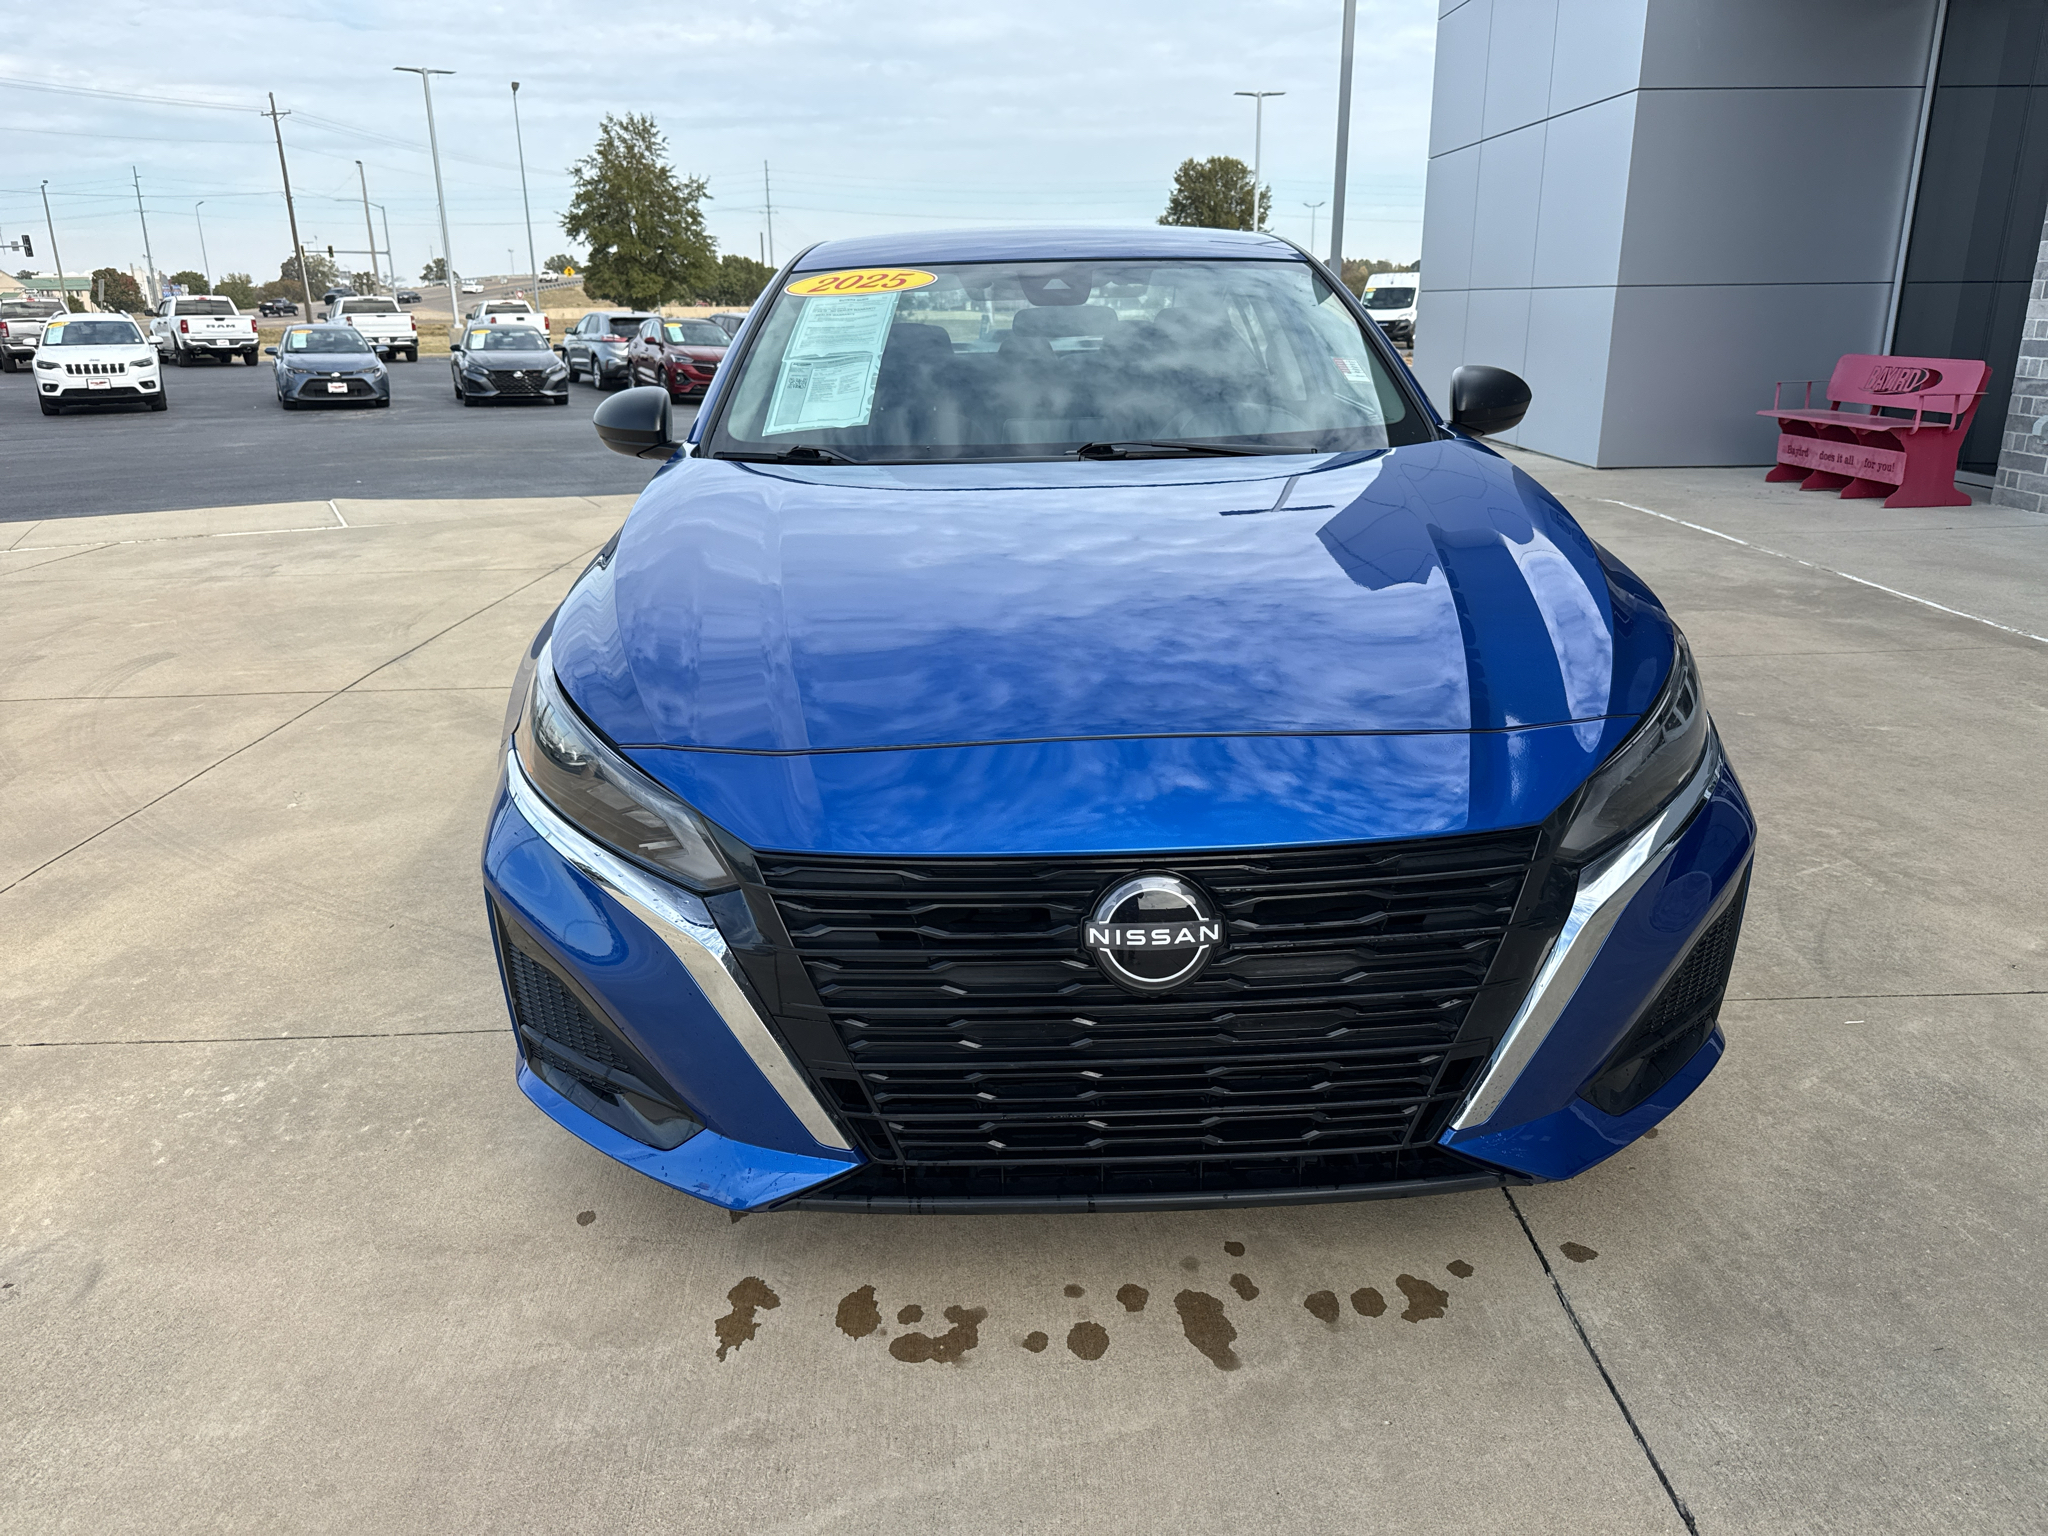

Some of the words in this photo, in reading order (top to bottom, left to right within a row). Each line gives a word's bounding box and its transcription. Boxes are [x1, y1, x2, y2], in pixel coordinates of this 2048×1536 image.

[807, 273, 915, 293] 2025
[1864, 365, 1922, 392] BAYIRD
[1787, 444, 1809, 458] Bayird
[1819, 450, 1835, 462] does
[1836, 453, 1843, 463] it
[1844, 455, 1854, 465] all
[1863, 458, 1876, 469] for
[1877, 461, 1895, 472] you!
[1089, 924, 1219, 945] NISSAN
